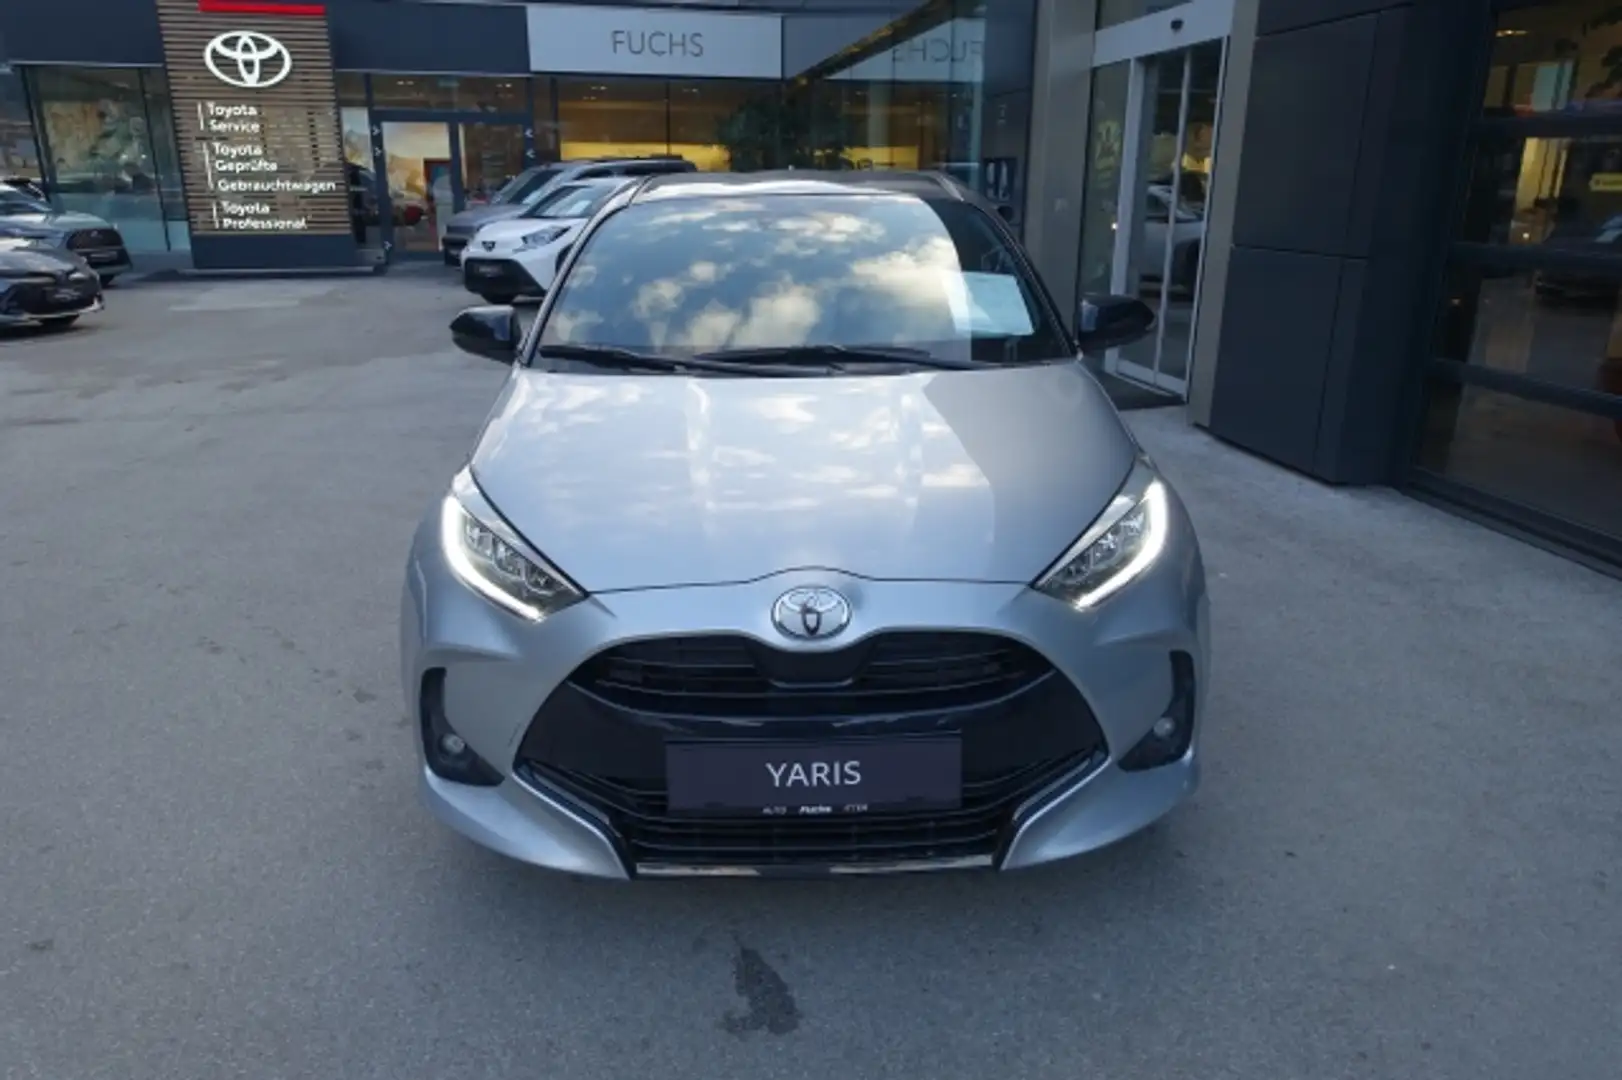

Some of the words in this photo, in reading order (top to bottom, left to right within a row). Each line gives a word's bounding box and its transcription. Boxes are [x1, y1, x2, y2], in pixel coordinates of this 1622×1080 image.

[611, 30, 704, 57] FUCHS
[207, 101, 258, 118] Toyota
[209, 119, 260, 133] Service
[212, 142, 263, 159] Toyota
[217, 178, 337, 194] Gebrauchtwagen
[221, 200, 271, 216] Toyota
[222, 217, 308, 230] Professional
[765, 760, 862, 788] YARIS
